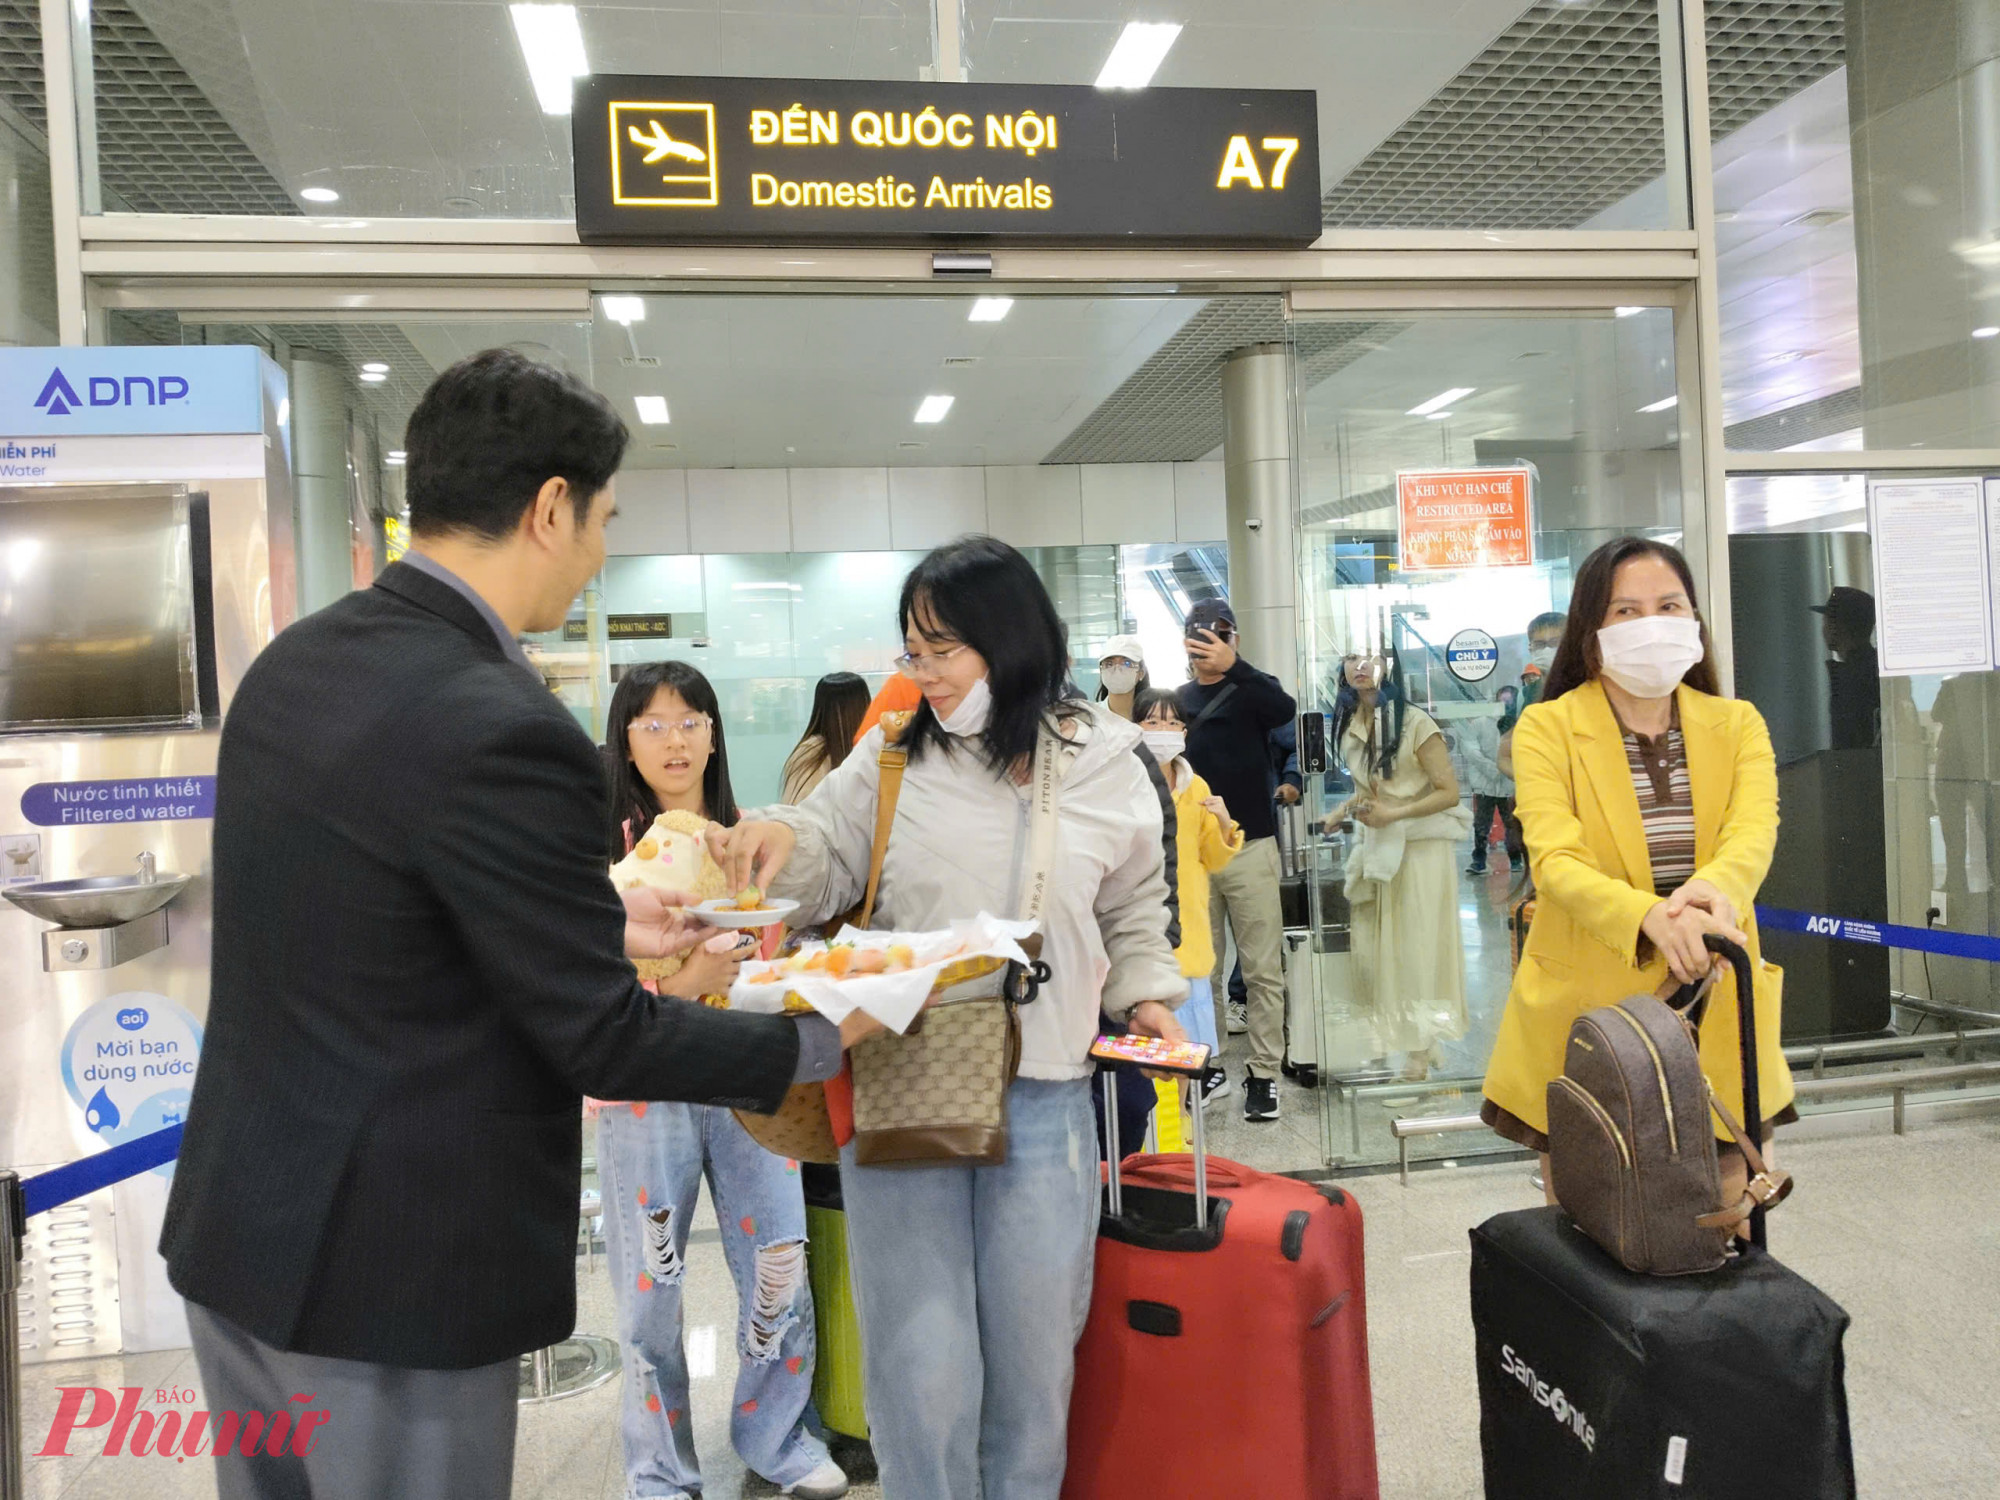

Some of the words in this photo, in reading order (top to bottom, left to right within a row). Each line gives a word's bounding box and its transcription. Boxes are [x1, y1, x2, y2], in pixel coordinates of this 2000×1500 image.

[748, 102, 839, 146] ĐẾN
[850, 105, 975, 149] QUỐC
[986, 109, 1058, 157] NỘI
[1216, 136, 1300, 190] A7
[751, 173, 916, 209] Domestic
[930, 175, 1053, 210] Arrivals
[31, 443, 56, 459] PHÍ
[0, 464, 46, 477] Water
[1415, 484, 1439, 498] KHU
[1441, 482, 1464, 499] VỰC
[1466, 482, 1489, 498] HẠN
[1491, 477, 1513, 495] CHẾ
[1416, 503, 1483, 517] RESTRICTED
[1486, 503, 1514, 515] AREA
[1503, 526, 1522, 541] VÀO
[1455, 650, 1479, 661] CHÚ
[54, 787, 109, 803] Nước
[154, 778, 203, 799] khiết
[61, 805, 136, 822] Filtered
[141, 804, 196, 819] water
[1806, 915, 1841, 936] ACV
[121, 1011, 145, 1025] aoi
[96, 1040, 134, 1059] Mời
[139, 1038, 179, 1059] bạn
[83, 1064, 137, 1083] dùng
[143, 1059, 194, 1078] nước
